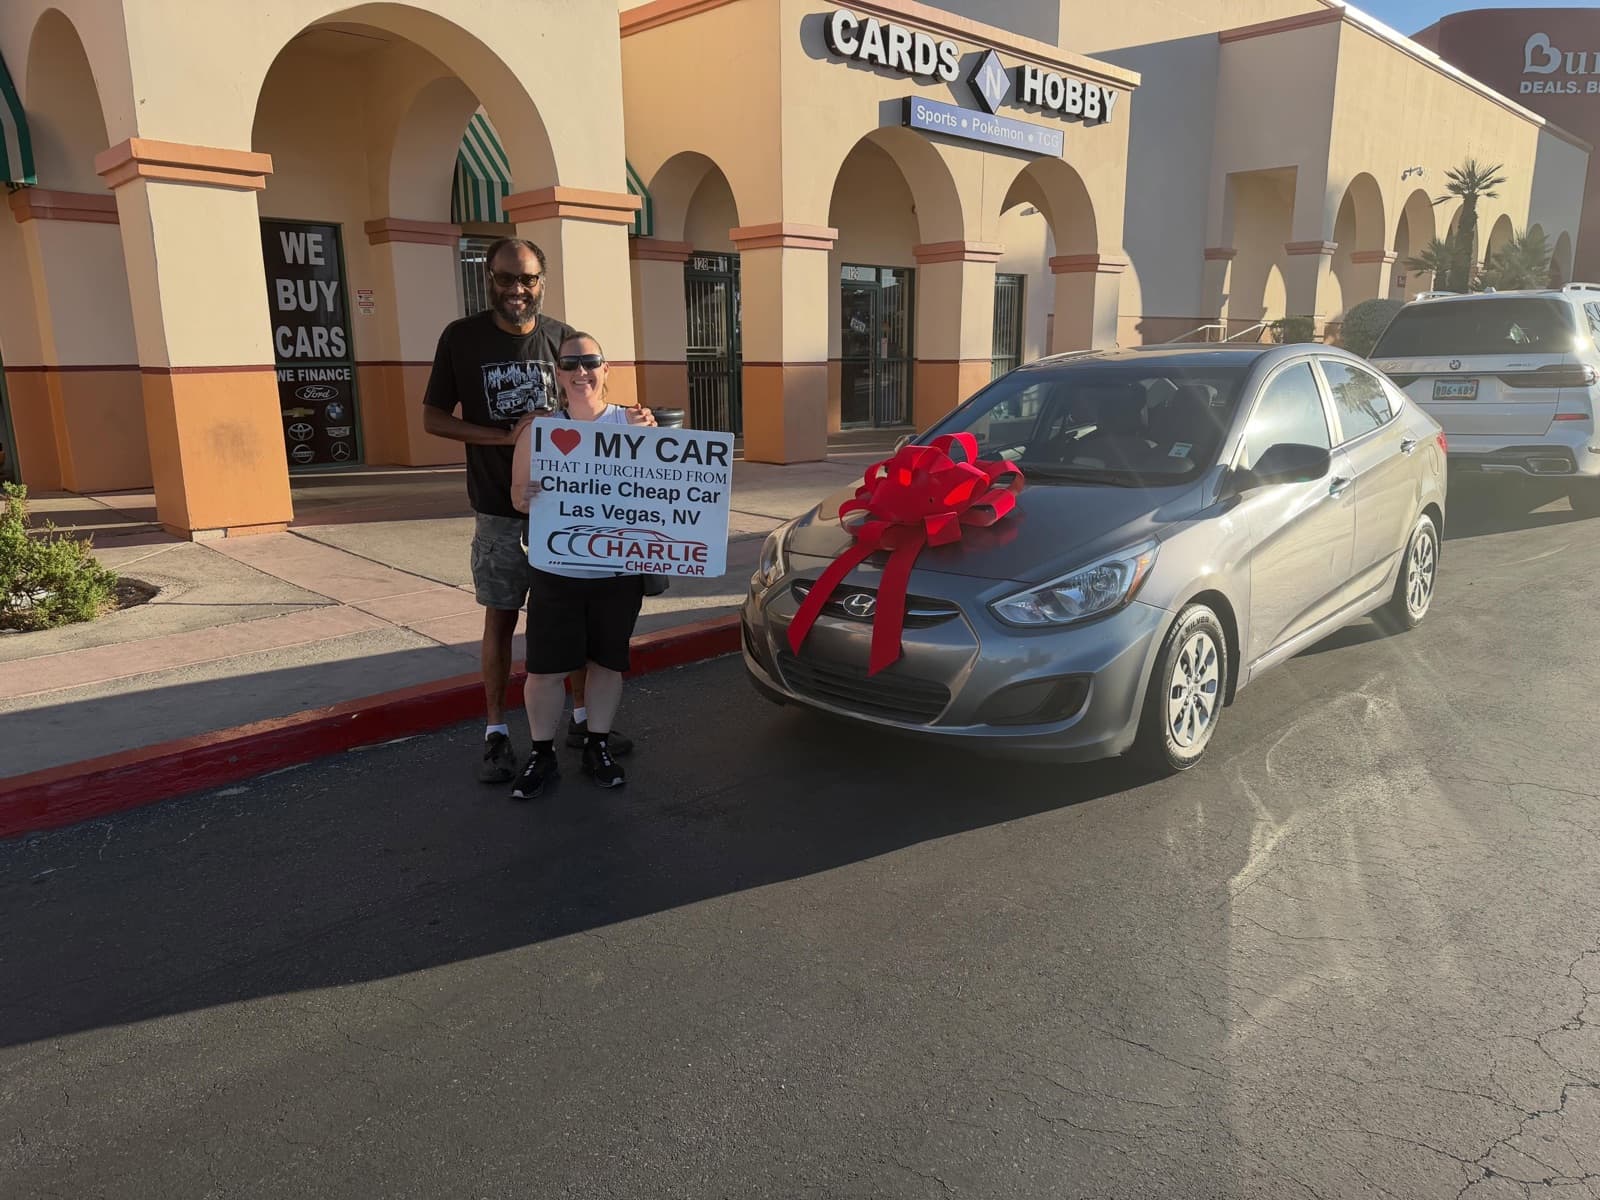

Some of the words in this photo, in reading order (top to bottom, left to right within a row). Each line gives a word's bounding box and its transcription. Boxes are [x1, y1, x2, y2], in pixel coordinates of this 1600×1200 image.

[831, 8, 960, 83] CARDS
[983, 68, 1001, 101] N
[1023, 65, 1120, 124] HOBBY
[1520, 81, 1581, 94] DEALS.
[1586, 81, 1600, 94] B
[916, 105, 957, 127] Sports
[1037, 131, 1059, 148] TCG
[279, 231, 325, 266] WE
[275, 278, 338, 312] BUY
[276, 325, 347, 358] CARS
[298, 368, 351, 382] FINANCE
[303, 386, 330, 399] Ford
[535, 427, 542, 453] I
[594, 431, 646, 460] MY
[655, 437, 729, 467] CAR
[537, 458, 581, 474] THAT
[585, 462, 589, 474] I
[594, 463, 682, 481] PURCHASED
[686, 470, 727, 485] FROM
[540, 475, 612, 496] Charlie
[618, 481, 681, 504] Cheap
[687, 486, 721, 504] Car
[559, 501, 594, 518] Las
[602, 504, 666, 527] Vegas,
[672, 509, 701, 525] NV
[625, 560, 672, 573] CHEAP
[677, 563, 705, 576] CAR
